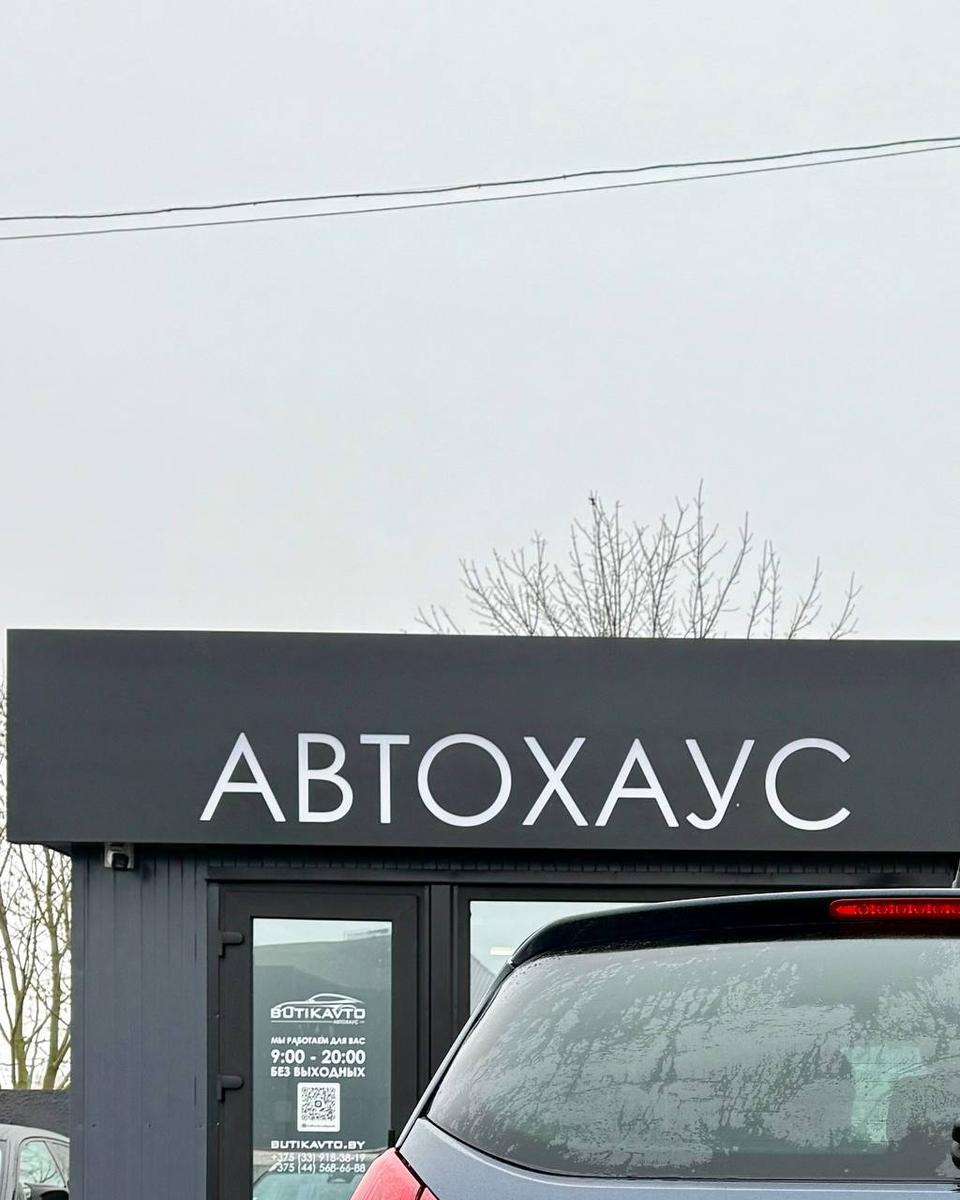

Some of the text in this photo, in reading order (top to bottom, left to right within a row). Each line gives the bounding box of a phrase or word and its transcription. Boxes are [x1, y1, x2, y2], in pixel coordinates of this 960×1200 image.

[200, 732, 851, 830] АВТОХАУС
[270, 1007, 366, 1019] BUTIKAVTO
[271, 1036, 366, 1046] МЫ РАБОТАЕМ ДЛЯ ВАС
[271, 1049, 305, 1064] 9:00
[321, 1049, 366, 1064] 20:00
[270, 1066, 366, 1078] БЕЗ ВЫХОДНЫХ
[270, 1140, 366, 1150] BUTIKAVTO.BY
[271, 1152, 295, 1162] +375
[297, 1152, 316, 1163] (33)
[271, 1163, 366, 1174] 375 (44) 568-66-88
